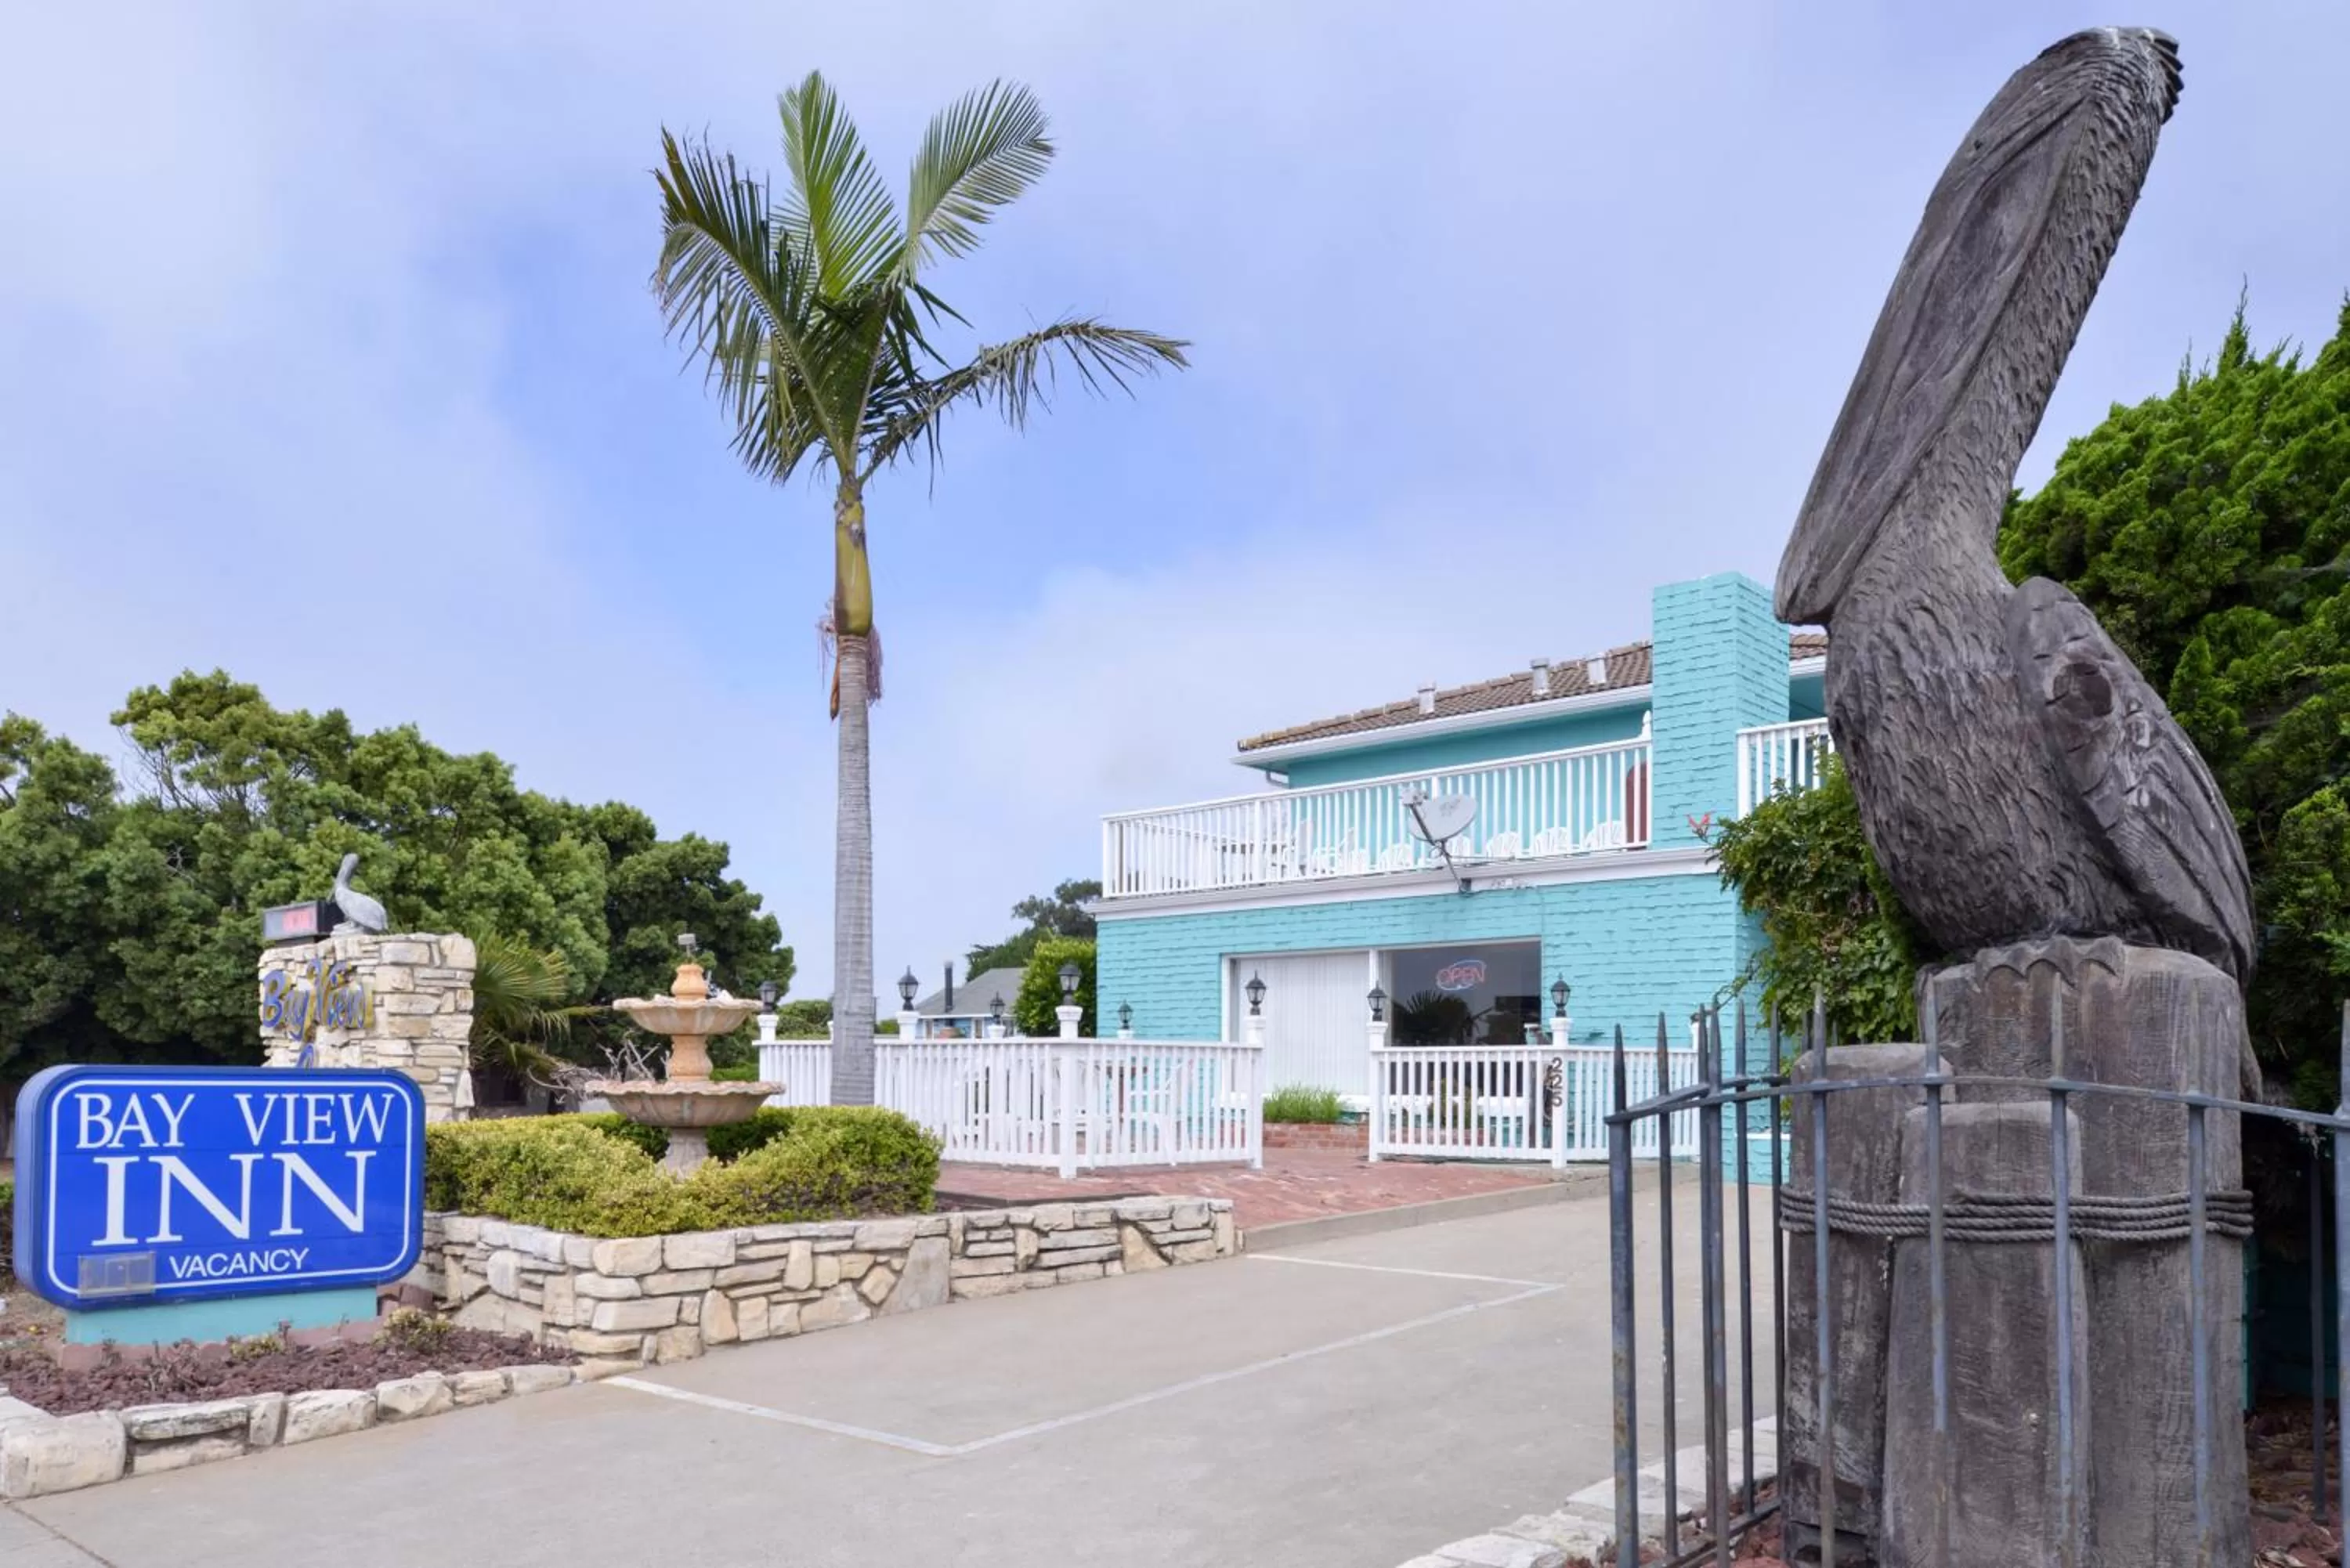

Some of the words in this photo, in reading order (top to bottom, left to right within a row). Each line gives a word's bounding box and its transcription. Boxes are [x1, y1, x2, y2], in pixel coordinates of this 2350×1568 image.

[1439, 966, 1484, 984] OPEN
[1551, 1057, 1563, 1107] 225
[74, 1092, 195, 1149] BAY
[233, 1093, 395, 1146] VIEW
[91, 1150, 377, 1247] INN
[169, 1248, 309, 1279] VACANCY
